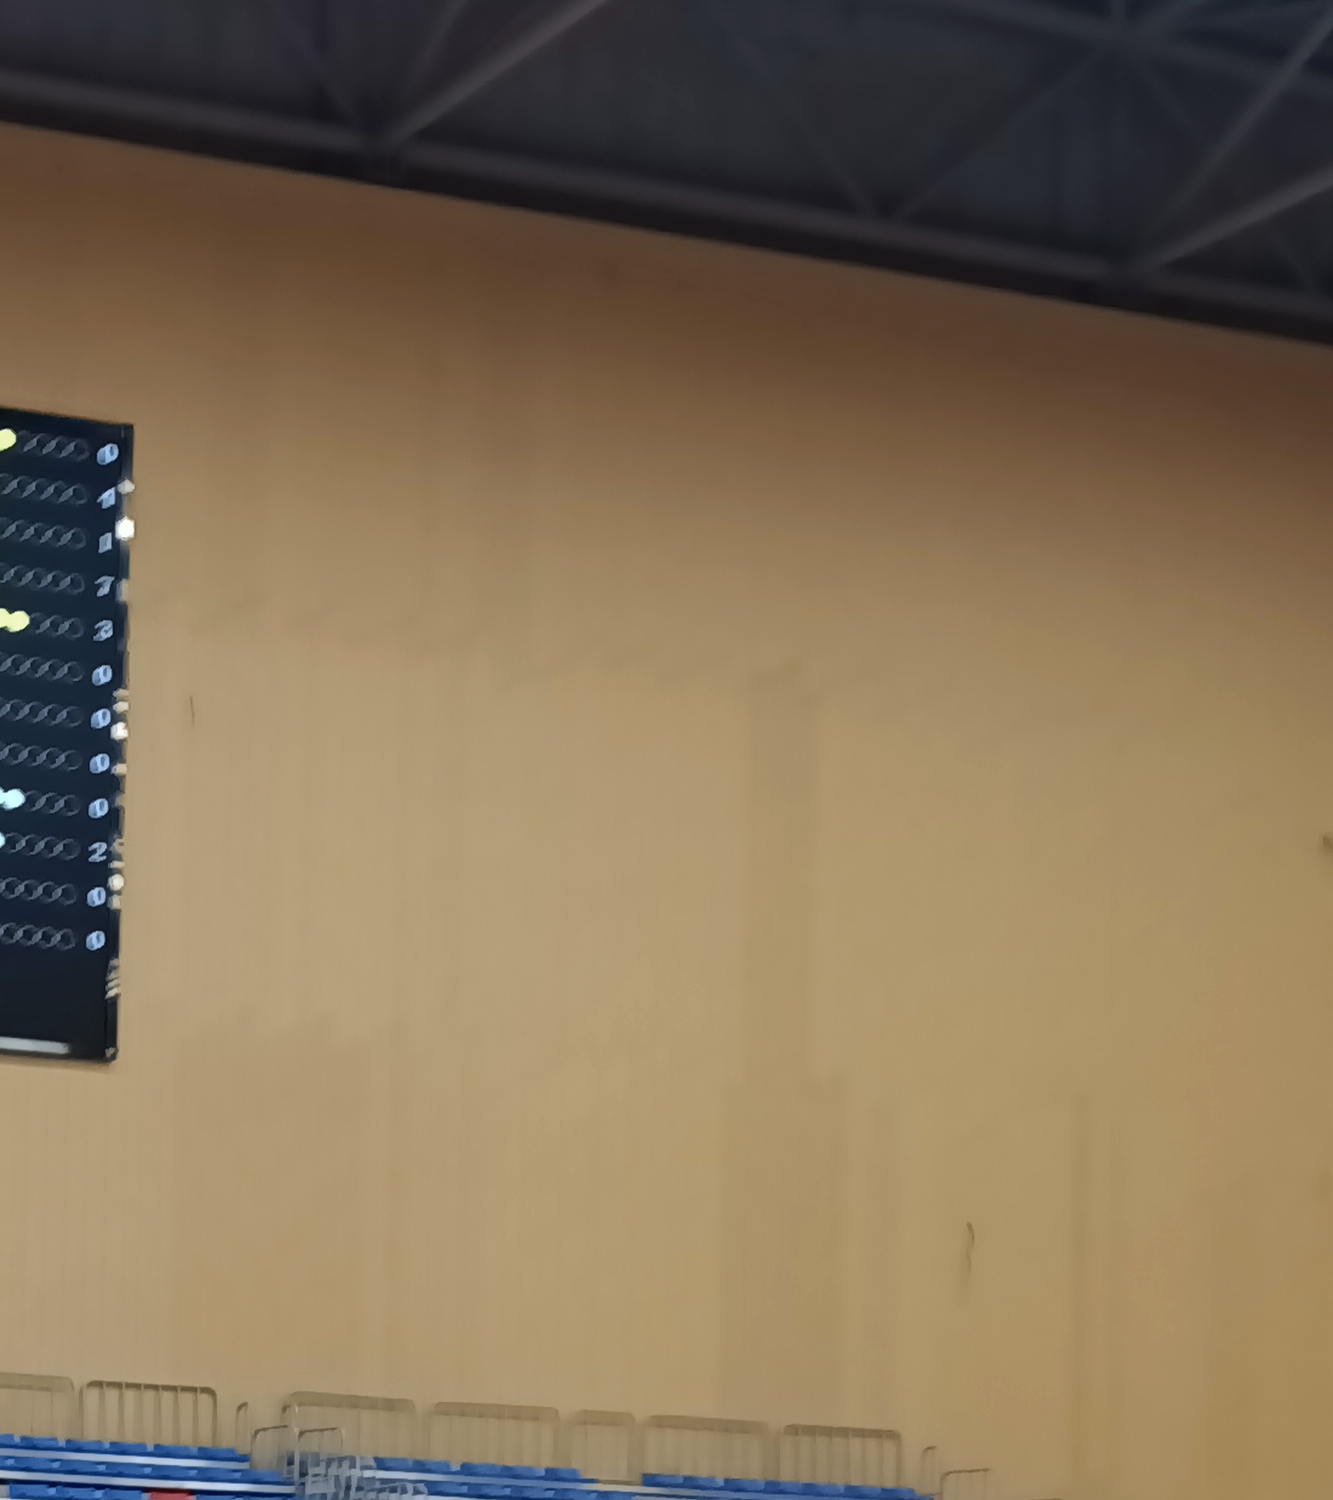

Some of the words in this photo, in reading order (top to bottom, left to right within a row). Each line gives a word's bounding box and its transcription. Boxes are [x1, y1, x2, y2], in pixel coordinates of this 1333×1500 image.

[97, 444, 119, 465] 0
[92, 665, 112, 685] 0
[91, 709, 111, 728] 0
[90, 754, 110, 773] 0
[89, 798, 109, 818] 0
[88, 842, 107, 862] 2
[87, 887, 106, 906] 0
[86, 931, 105, 950] 0
